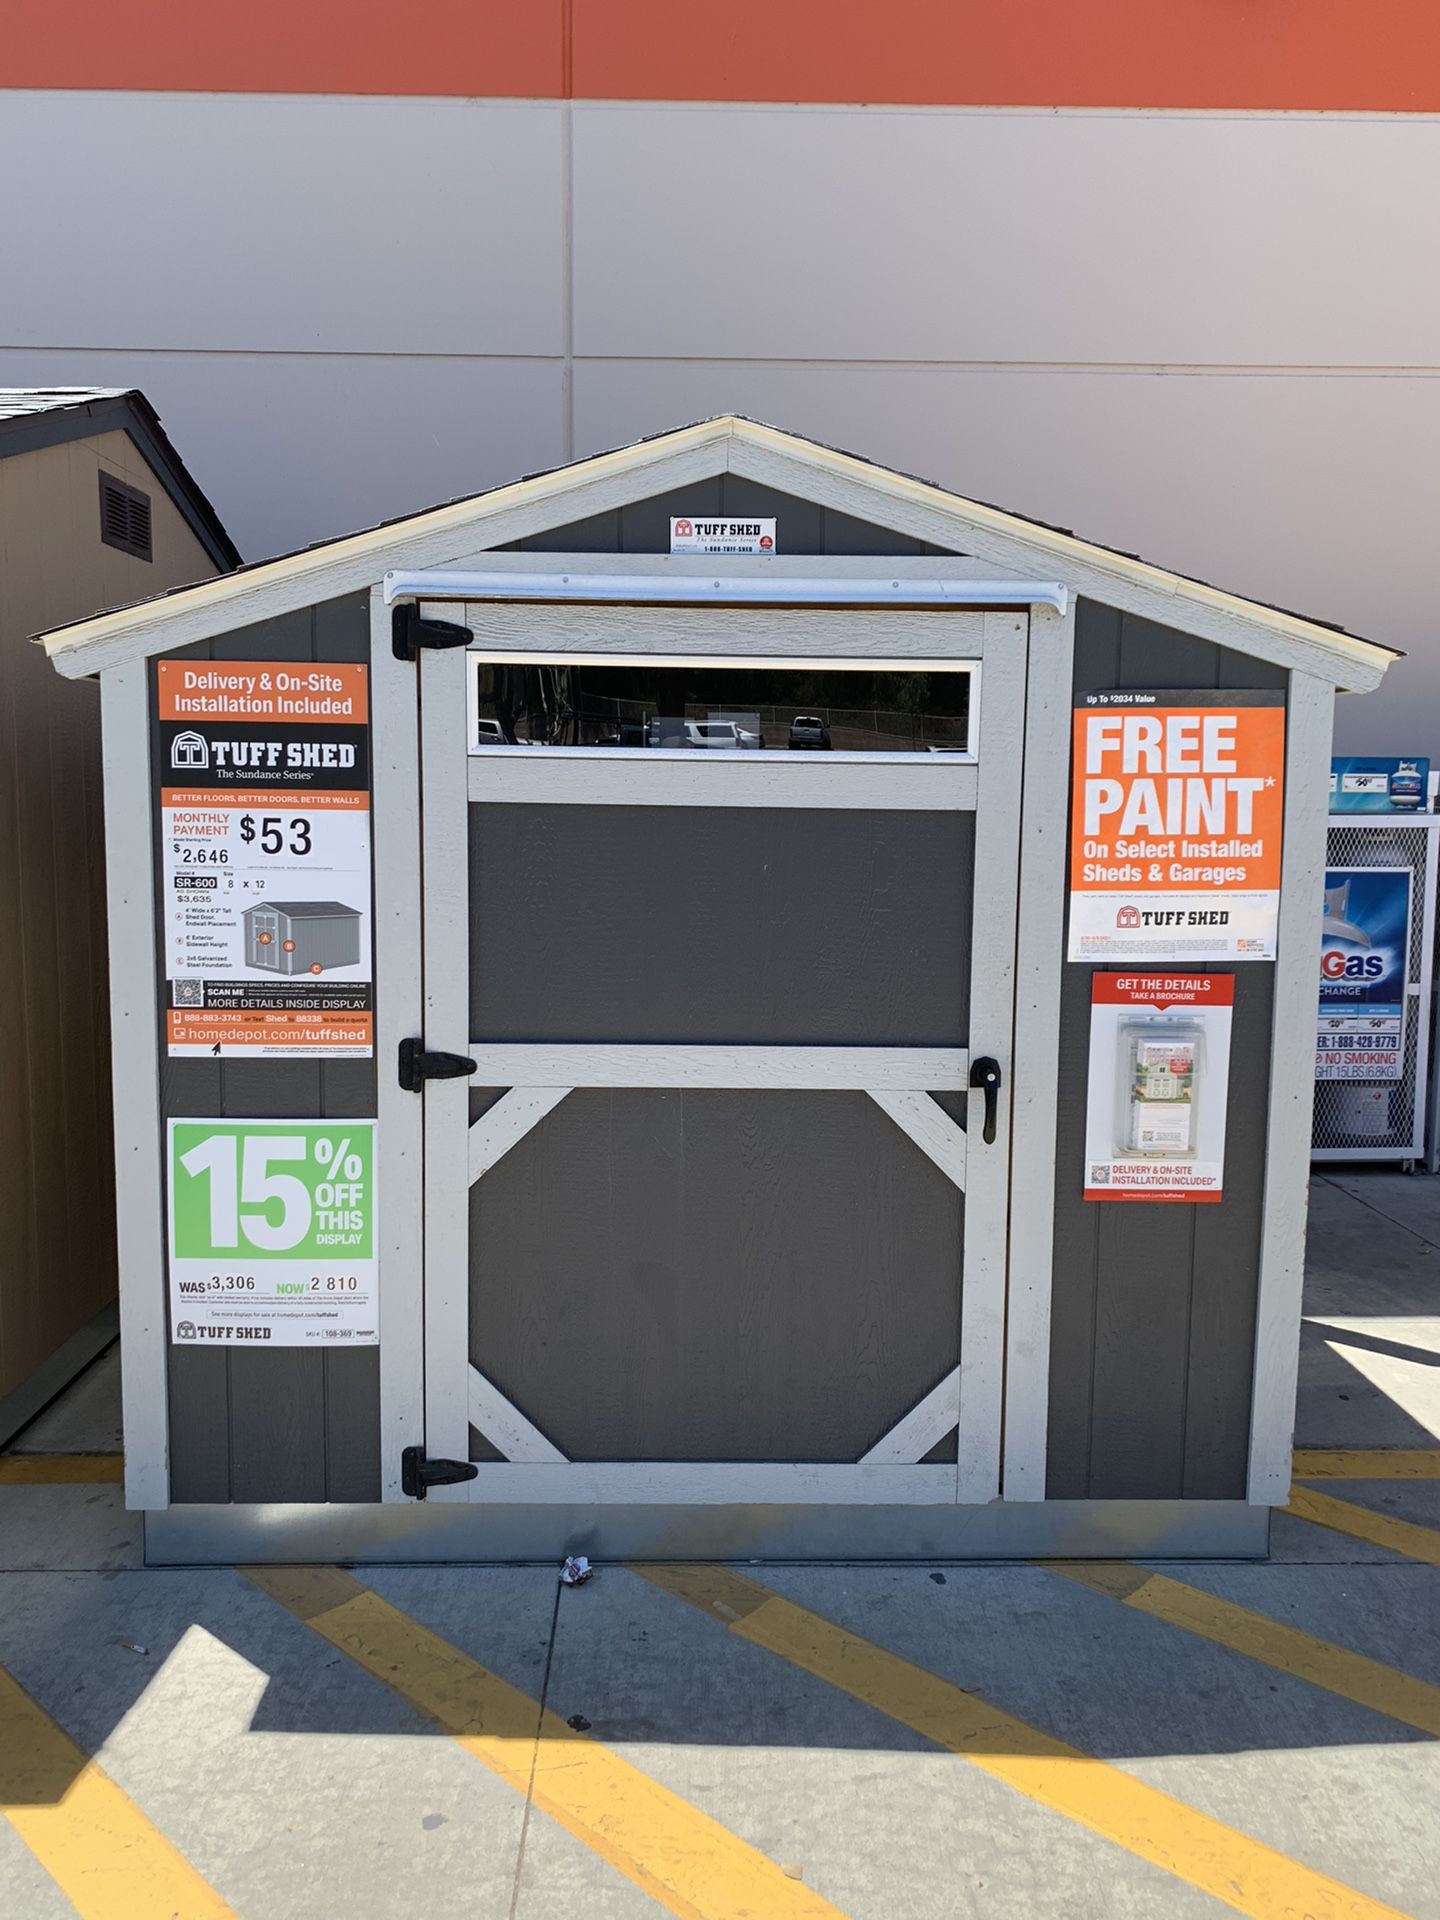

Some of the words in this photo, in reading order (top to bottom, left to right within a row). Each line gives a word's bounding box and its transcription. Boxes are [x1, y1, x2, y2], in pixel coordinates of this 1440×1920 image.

[695, 524, 728, 536] TUFF
[730, 524, 761, 536] SHED
[184, 671, 255, 693] Delivery
[259, 673, 272, 691] &
[276, 673, 342, 692] On-Site
[175, 694, 273, 713] Installation
[278, 696, 353, 715] Included
[1086, 694, 1097, 704] Up
[1099, 695, 1108, 703] To
[1110, 694, 1133, 704] $2034
[1134, 694, 1156, 703] Value
[1085, 715, 1237, 774] FREE
[211, 741, 283, 766] TUFF
[287, 742, 356, 768] SHED
[216, 769, 234, 779] The
[236, 770, 282, 779] Sundance
[172, 794, 202, 803] BETTER
[203, 794, 236, 804] FLOORS,
[238, 795, 268, 803] BETTER
[269, 795, 300, 804] DOORS,
[301, 796, 331, 804] BETTER
[332, 796, 360, 805] WALLS
[173, 813, 230, 823] MONTHLY
[173, 826, 230, 836] PAYMENT
[240, 814, 312, 856] $53
[173, 843, 229, 864] $2,646
[1084, 840, 1108, 858] On
[1115, 840, 1175, 859] Select
[1182, 840, 1263, 858] Installed
[1083, 864, 1142, 882] Sheds
[1148, 865, 1163, 882] &
[1169, 864, 1246, 885] Garages
[176, 878, 216, 888] SR-600
[228, 879, 234, 888] 8
[255, 880, 265, 888] 12
[177, 895, 212, 903] $3,635
[1142, 911, 1185, 926] TUFF
[1188, 912, 1230, 926] SHED
[1116, 978, 1138, 990] GET
[1140, 979, 1163, 990] THE
[1164, 979, 1211, 991] DETAILS
[207, 988, 231, 996] SCAN
[232, 988, 244, 996] ME
[1131, 992, 1149, 1000] TAKE
[1150, 992, 1155, 1000] A
[1156, 992, 1195, 1001] BROCHURE
[207, 999, 239, 1008] MORE
[241, 999, 284, 1008] DETAILS
[286, 999, 320, 1009] INSIDE
[322, 1000, 366, 1009] DISPLAY
[266, 1014, 288, 1023] Shed
[189, 1028, 366, 1042] homedepot.com/tuffshed
[1331, 1036, 1397, 1048] 1-888-428-9779
[1325, 1053, 1342, 1065] NO
[1344, 1053, 1397, 1065] SMOKING
[1112, 1165, 1152, 1175] DELIVERY
[1152, 1166, 1159, 1175] &
[1160, 1166, 1193, 1175] ON-SITE
[1112, 1175, 1171, 1185] INSTALLATION
[315, 1183, 363, 1208] OFF
[315, 1210, 364, 1231] THIS
[316, 1233, 362, 1245] DISPLAY
[179, 1282, 206, 1293] WAS
[276, 1283, 305, 1294] NOW
[197, 1326, 234, 1339] TUFF
[236, 1327, 271, 1339] SHED
